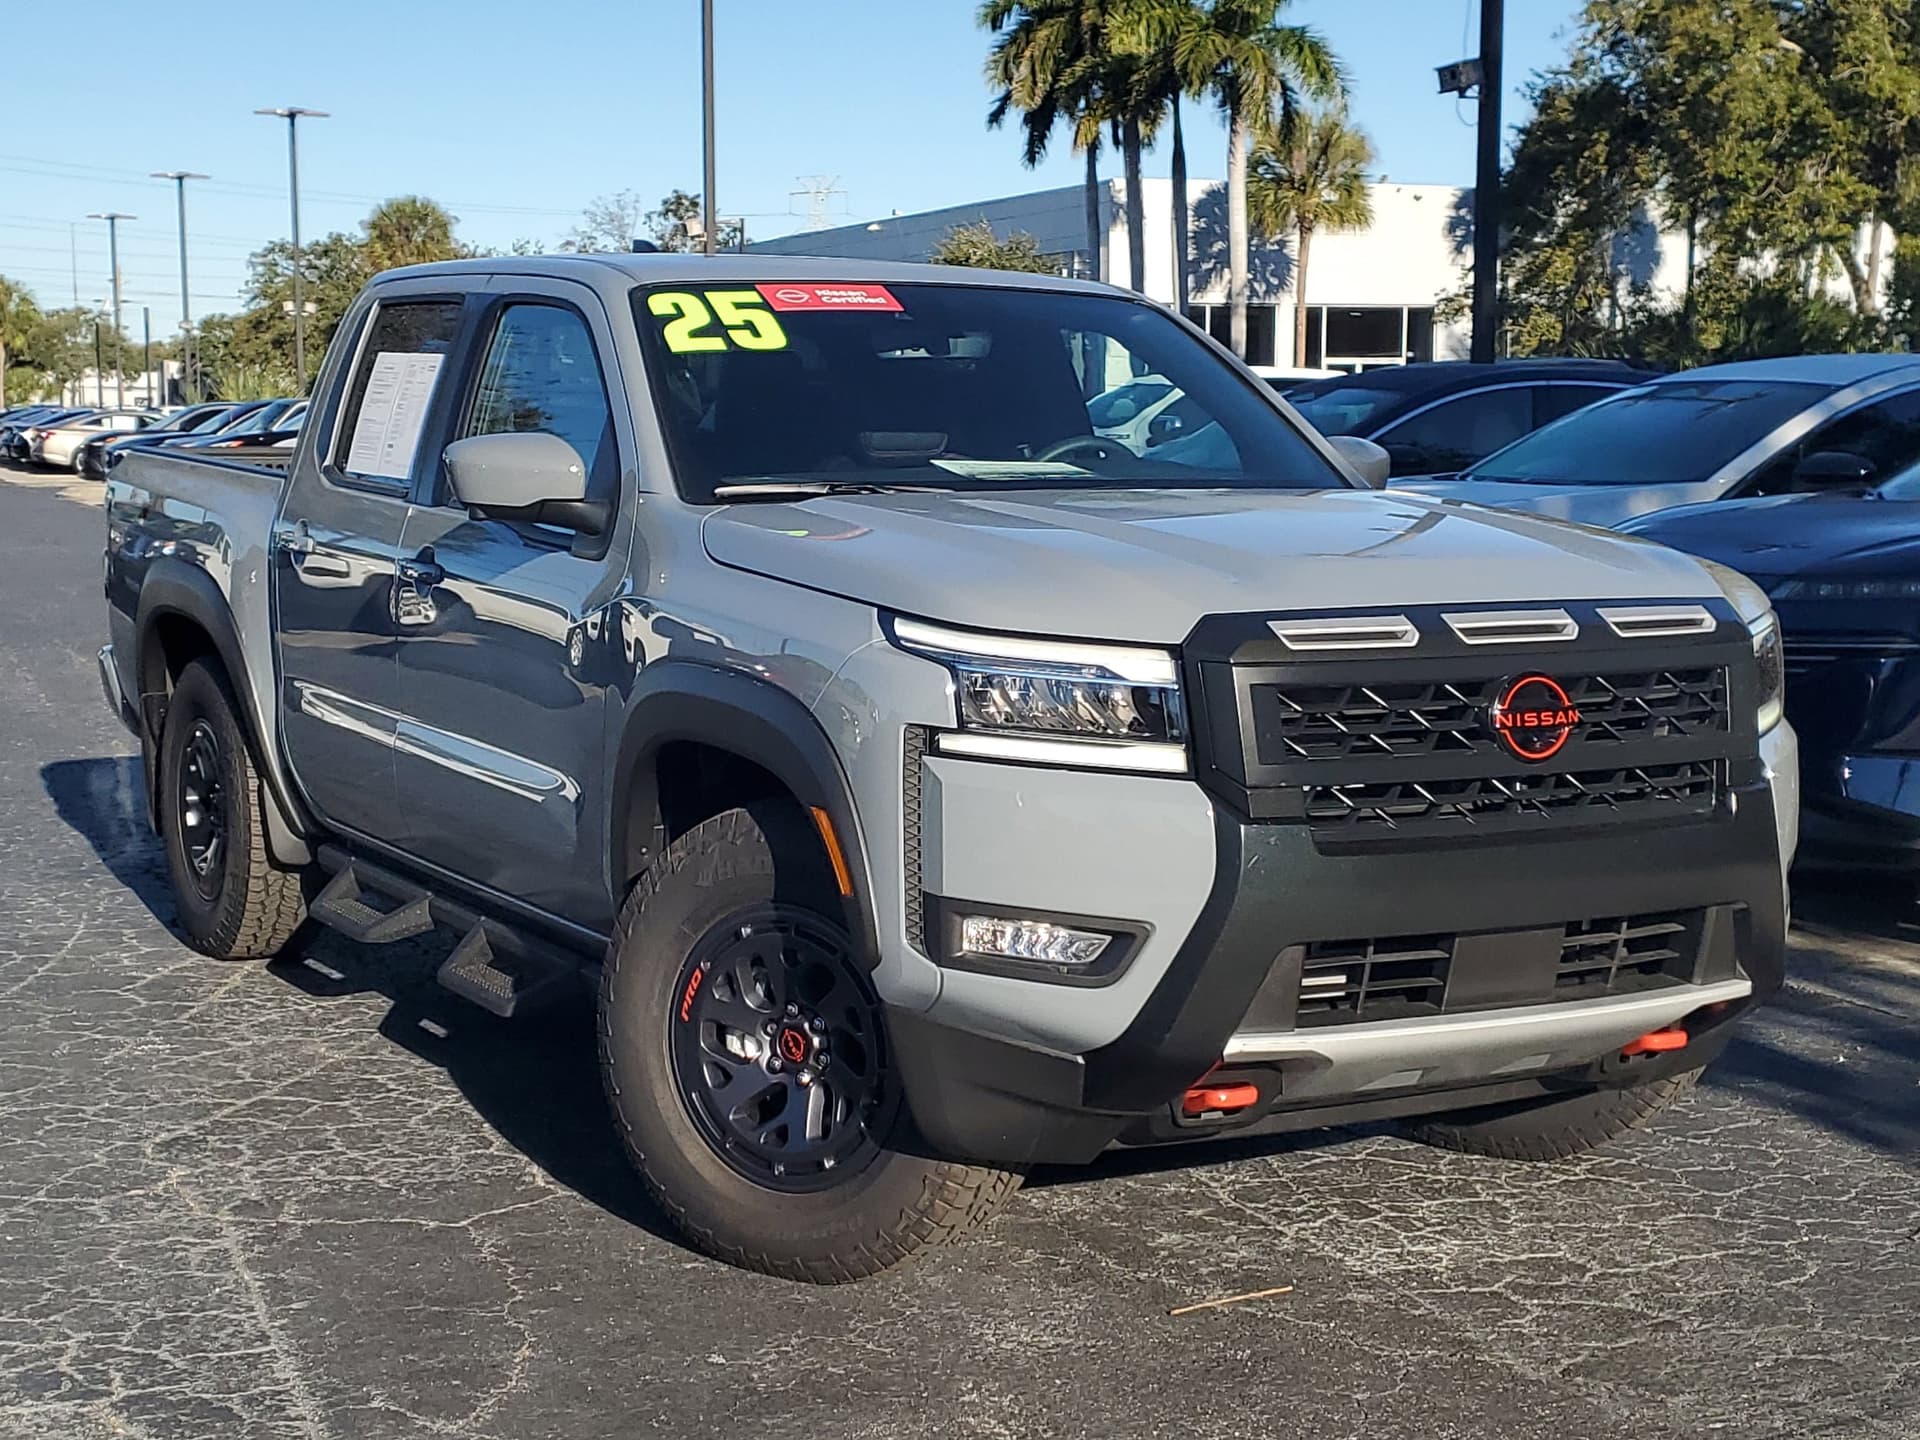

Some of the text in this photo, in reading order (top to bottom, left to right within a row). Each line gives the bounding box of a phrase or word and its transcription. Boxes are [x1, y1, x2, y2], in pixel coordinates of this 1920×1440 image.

[814, 289, 867, 297] Nissan
[821, 296, 887, 304] Certified
[647, 291, 787, 353] 25
[1495, 709, 1580, 727] NISSAN
[681, 967, 702, 1022] PRO
